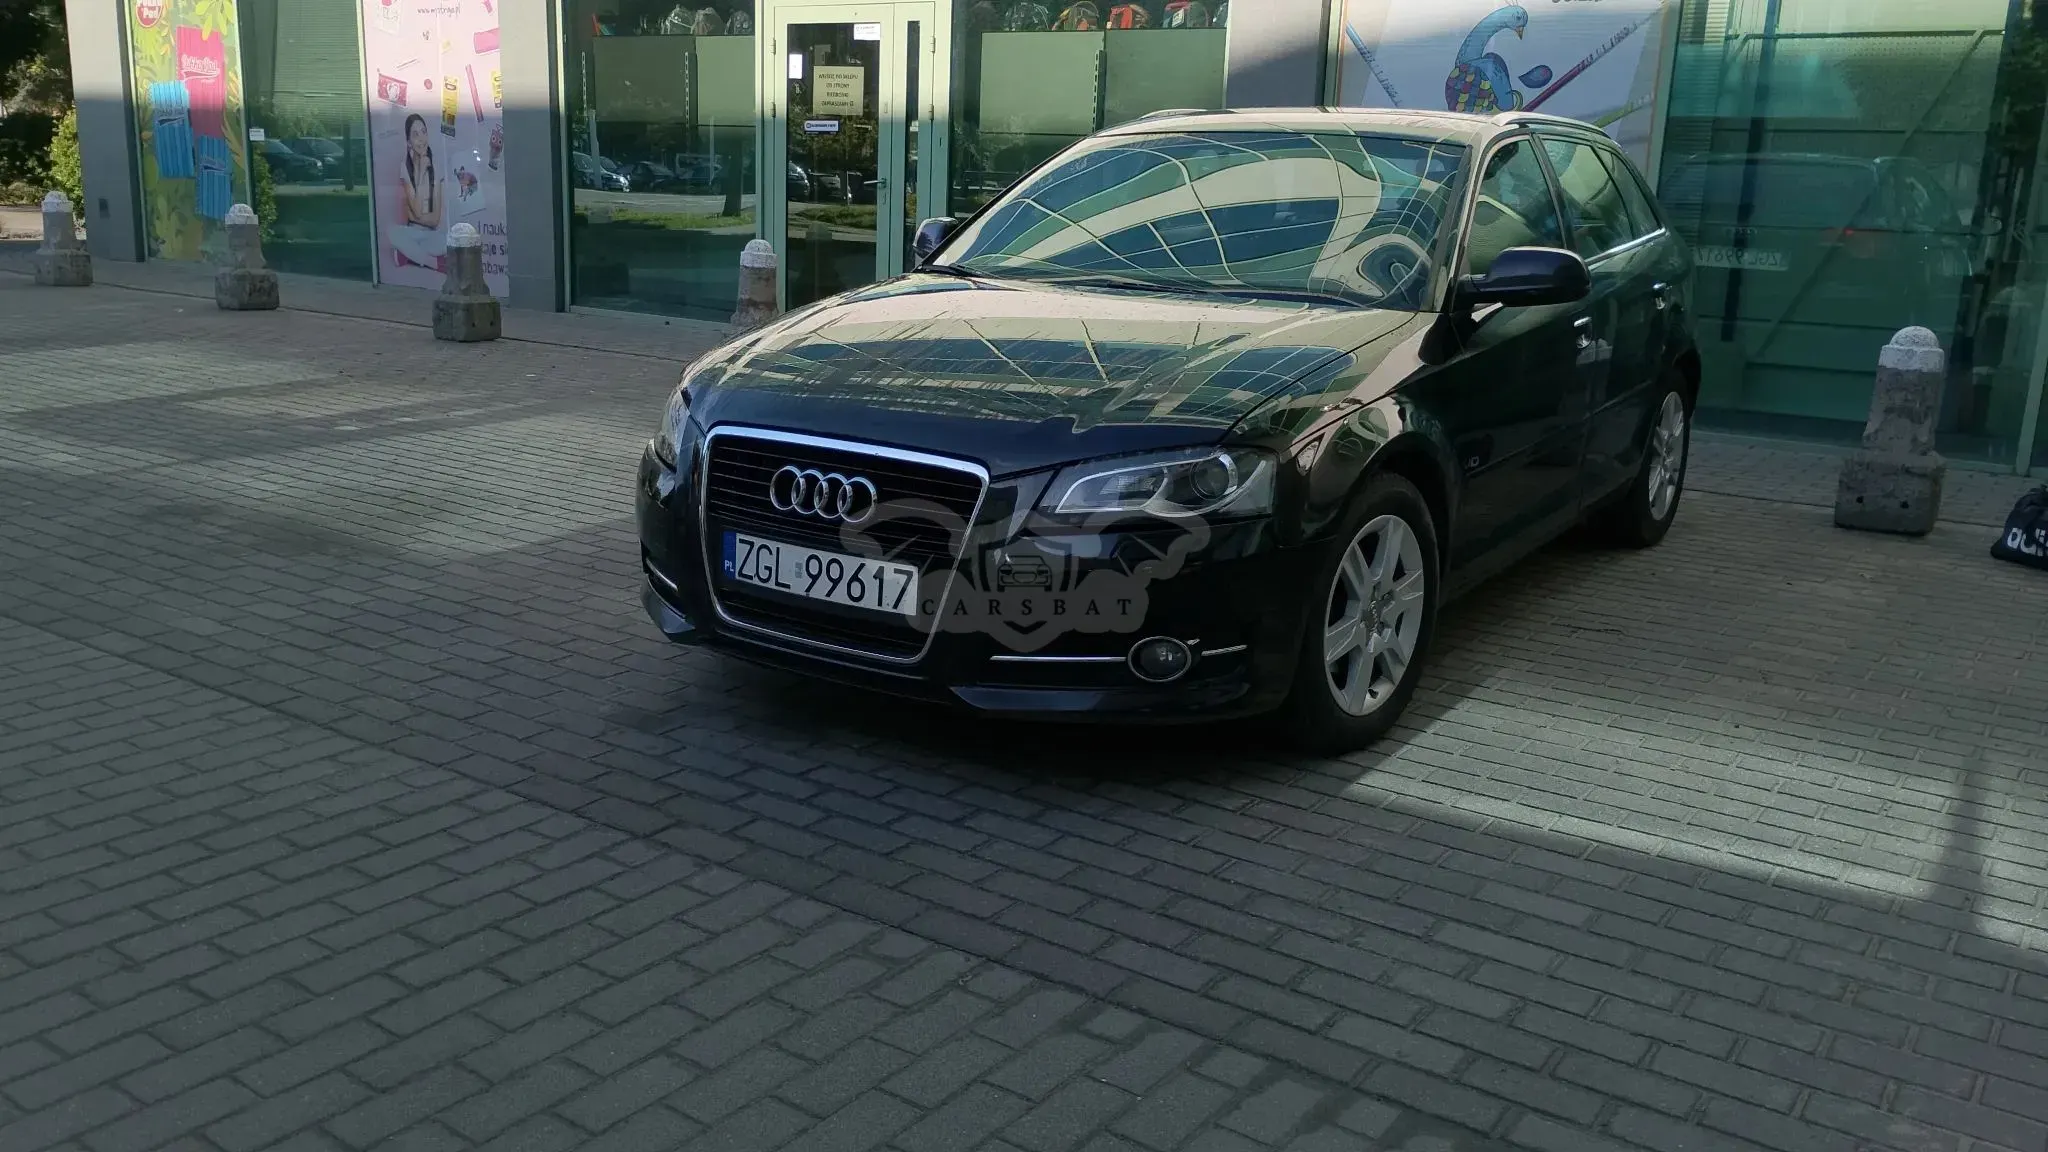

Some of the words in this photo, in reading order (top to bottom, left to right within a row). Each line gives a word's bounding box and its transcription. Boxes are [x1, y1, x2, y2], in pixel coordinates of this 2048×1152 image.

[483, 222, 509, 236] nauk
[724, 561, 735, 573] PL
[737, 538, 791, 590] ZGL
[804, 553, 915, 610] 99617
